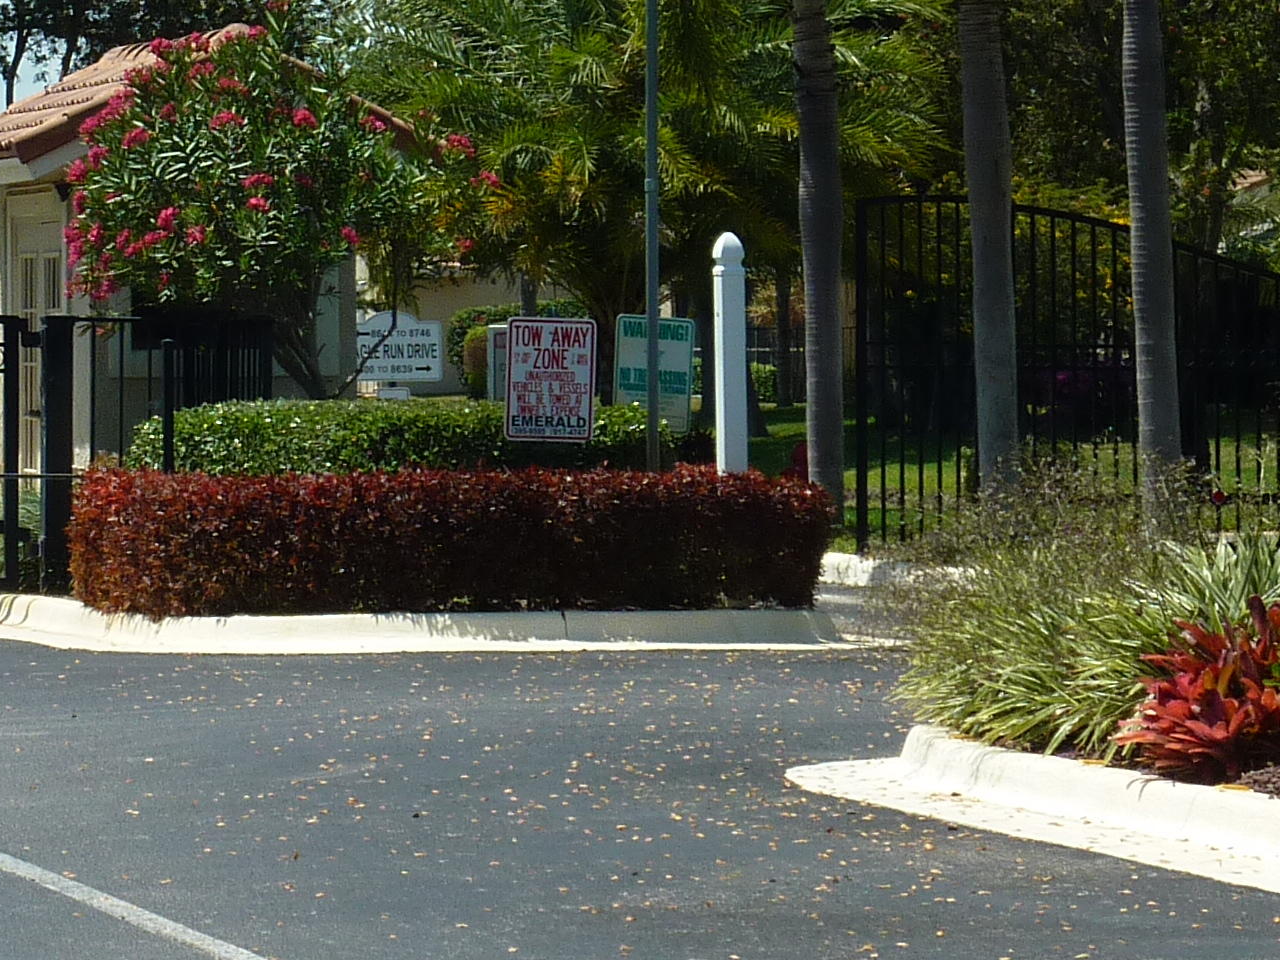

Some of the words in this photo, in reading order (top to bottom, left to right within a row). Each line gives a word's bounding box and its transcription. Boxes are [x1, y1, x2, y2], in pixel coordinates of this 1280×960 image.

[409, 329, 431, 337] 8746
[514, 325, 543, 347] TOW
[551, 326, 590, 348] AWAY
[383, 344, 404, 359] RUN
[407, 343, 438, 359] DRIVE
[533, 348, 569, 370] ZONE
[525, 370, 576, 382] UNAUTHORIZED
[512, 381, 543, 393] VEHICLES
[548, 382, 554, 393] &
[559, 383, 588, 394] VESSELS
[516, 393, 531, 405] WILL
[549, 394, 571, 405] TOWED
[551, 406, 581, 416] EXPENSE
[511, 415, 587, 428] EMERALD
